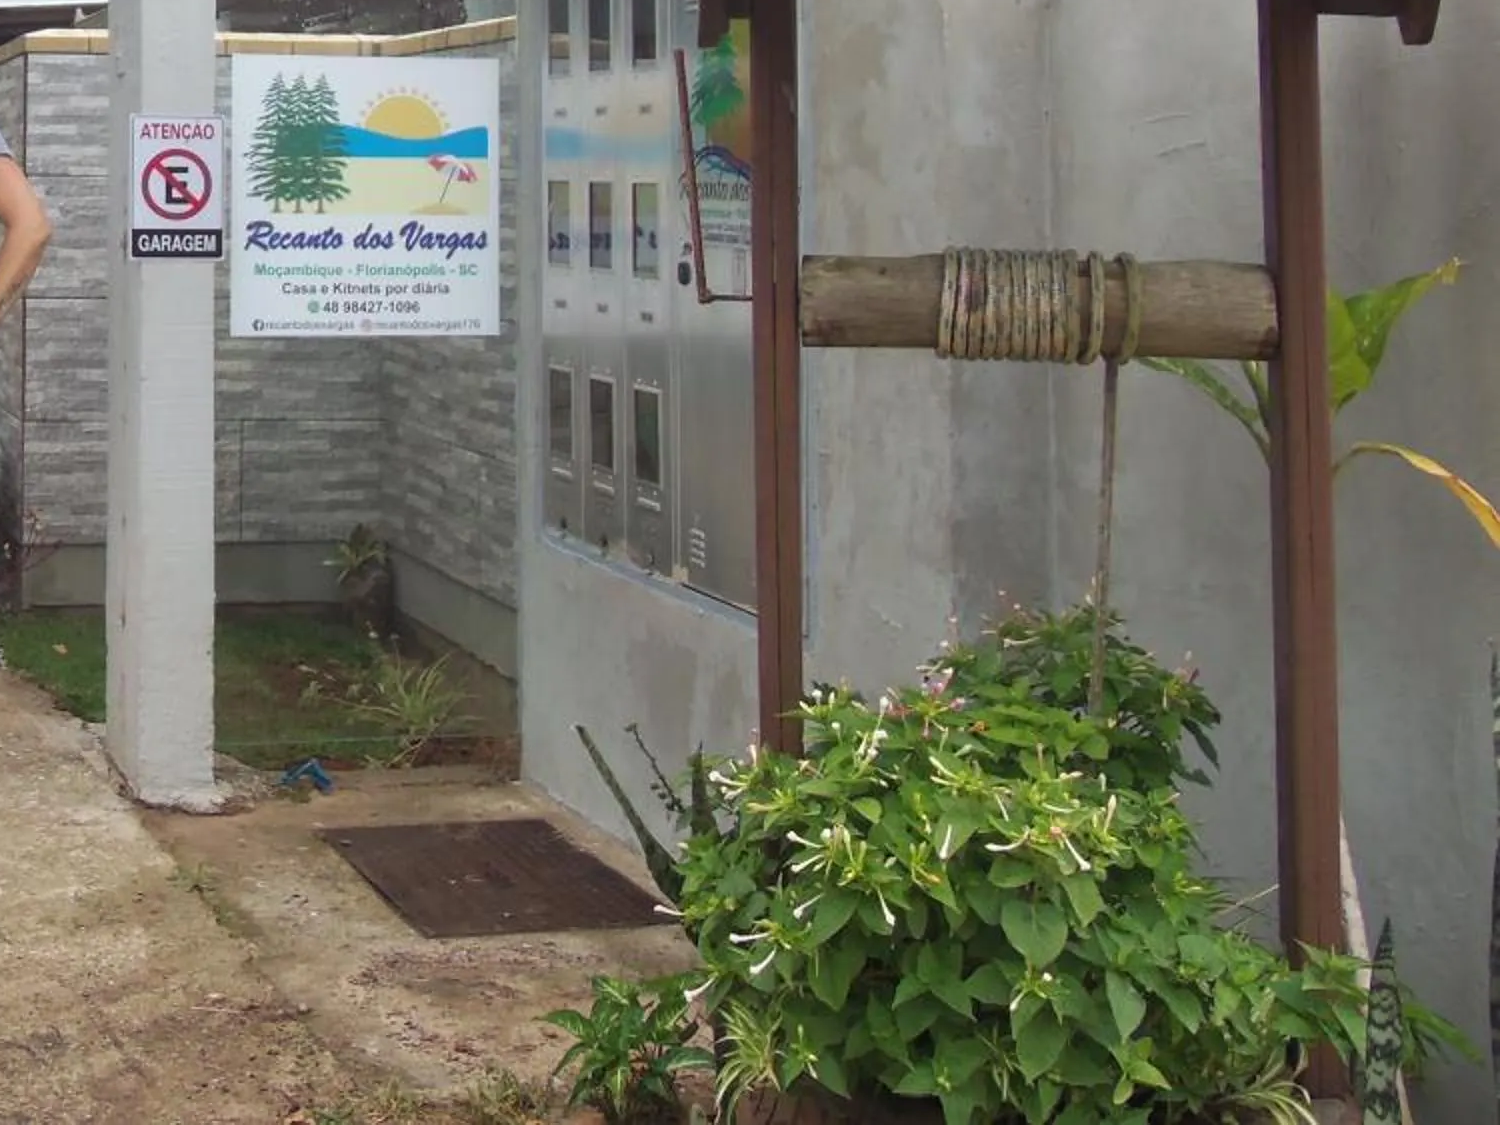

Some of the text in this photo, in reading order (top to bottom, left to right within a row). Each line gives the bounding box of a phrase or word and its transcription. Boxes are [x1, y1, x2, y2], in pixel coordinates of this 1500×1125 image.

[137, 234, 218, 253] GARAGEM
[244, 220, 489, 260] Recanto dos Vargas
[253, 263, 344, 279] Moçambique
[356, 262, 446, 279] Florianópolis
[458, 263, 479, 276] SC
[281, 281, 450, 298] Casa e Kitnets por diária
[322, 300, 339, 314] 48
